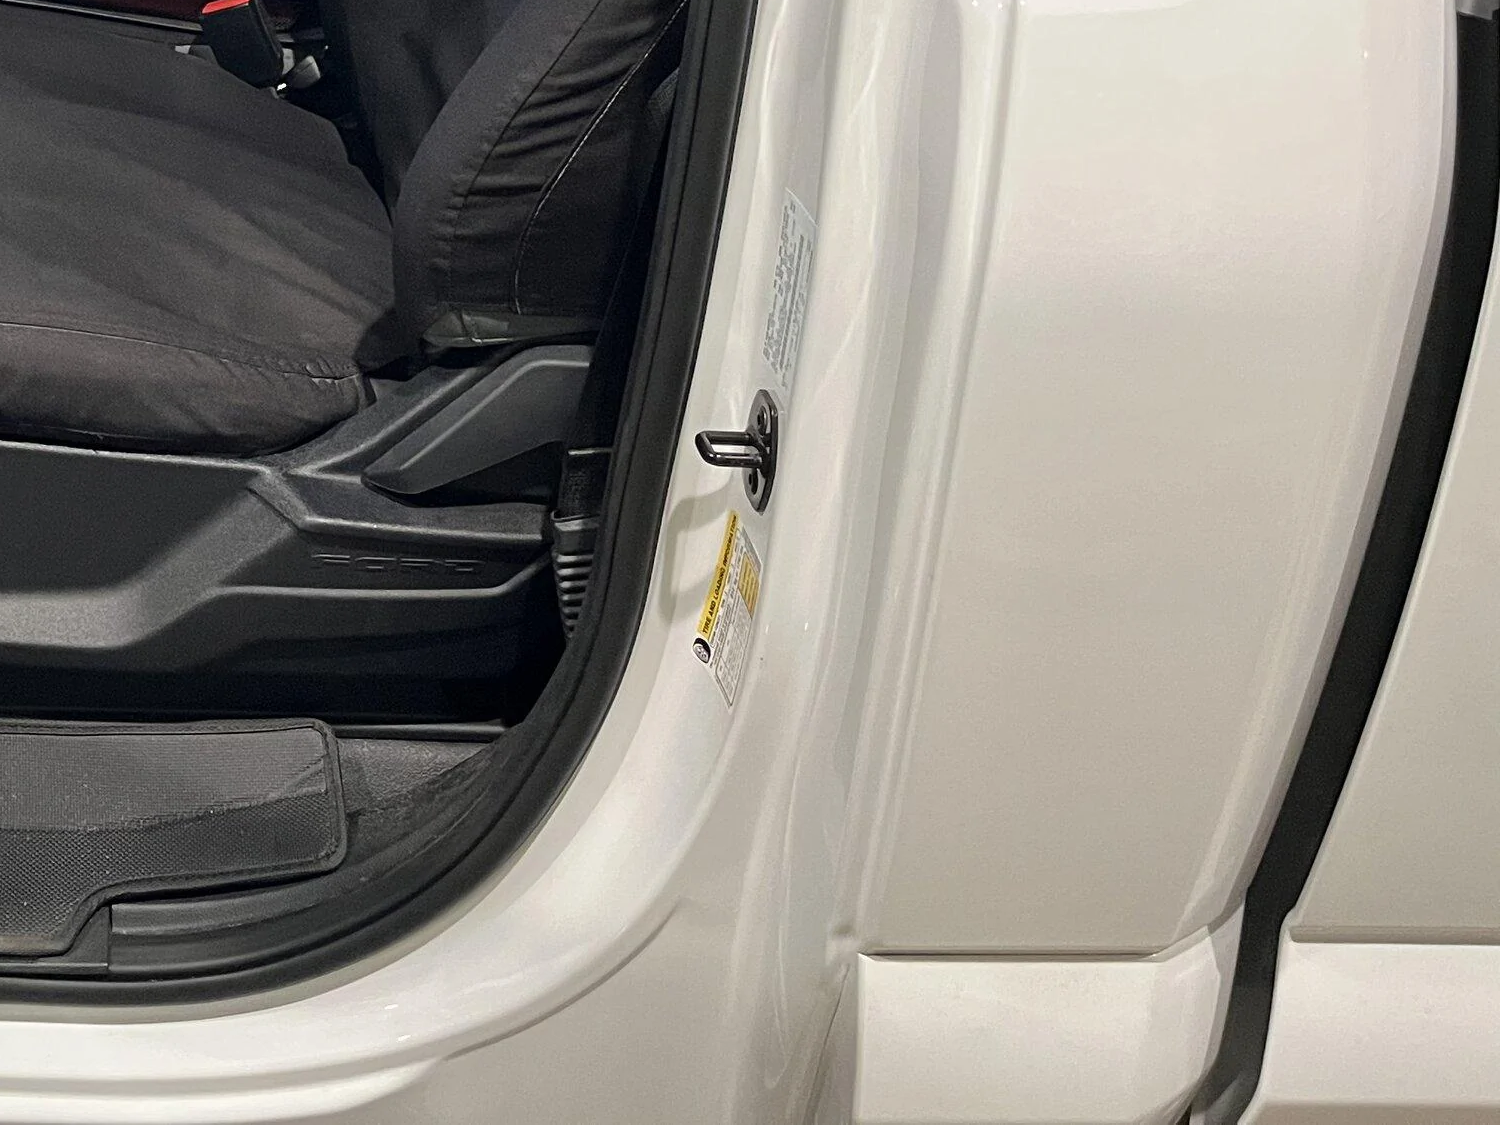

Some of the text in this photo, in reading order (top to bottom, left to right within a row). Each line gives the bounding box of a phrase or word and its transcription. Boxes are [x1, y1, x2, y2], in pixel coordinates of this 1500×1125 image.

[311, 553, 486, 574] FORD
[702, 617, 712, 634] TIRE
[708, 600, 716, 617] AND
[714, 567, 725, 600] LOADING
